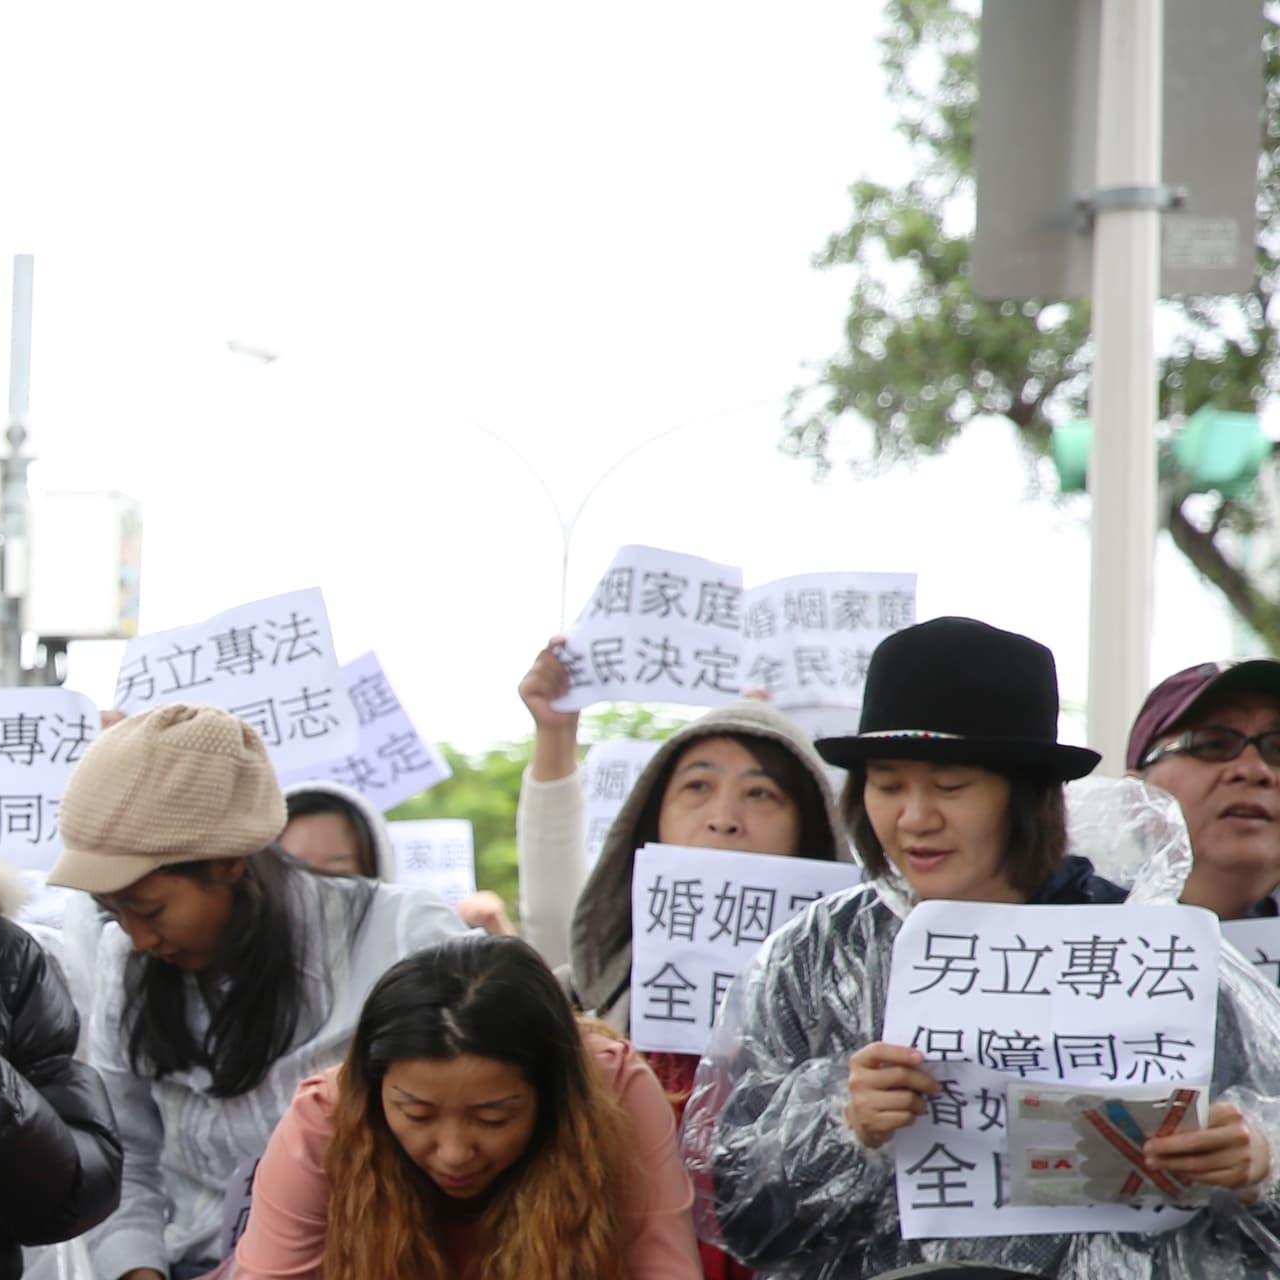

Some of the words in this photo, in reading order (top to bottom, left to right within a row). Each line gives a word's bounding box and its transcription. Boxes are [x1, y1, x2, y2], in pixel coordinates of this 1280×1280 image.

[113, 611, 324, 707] 另立專法
[908, 930, 1200, 1001] 另立專法
